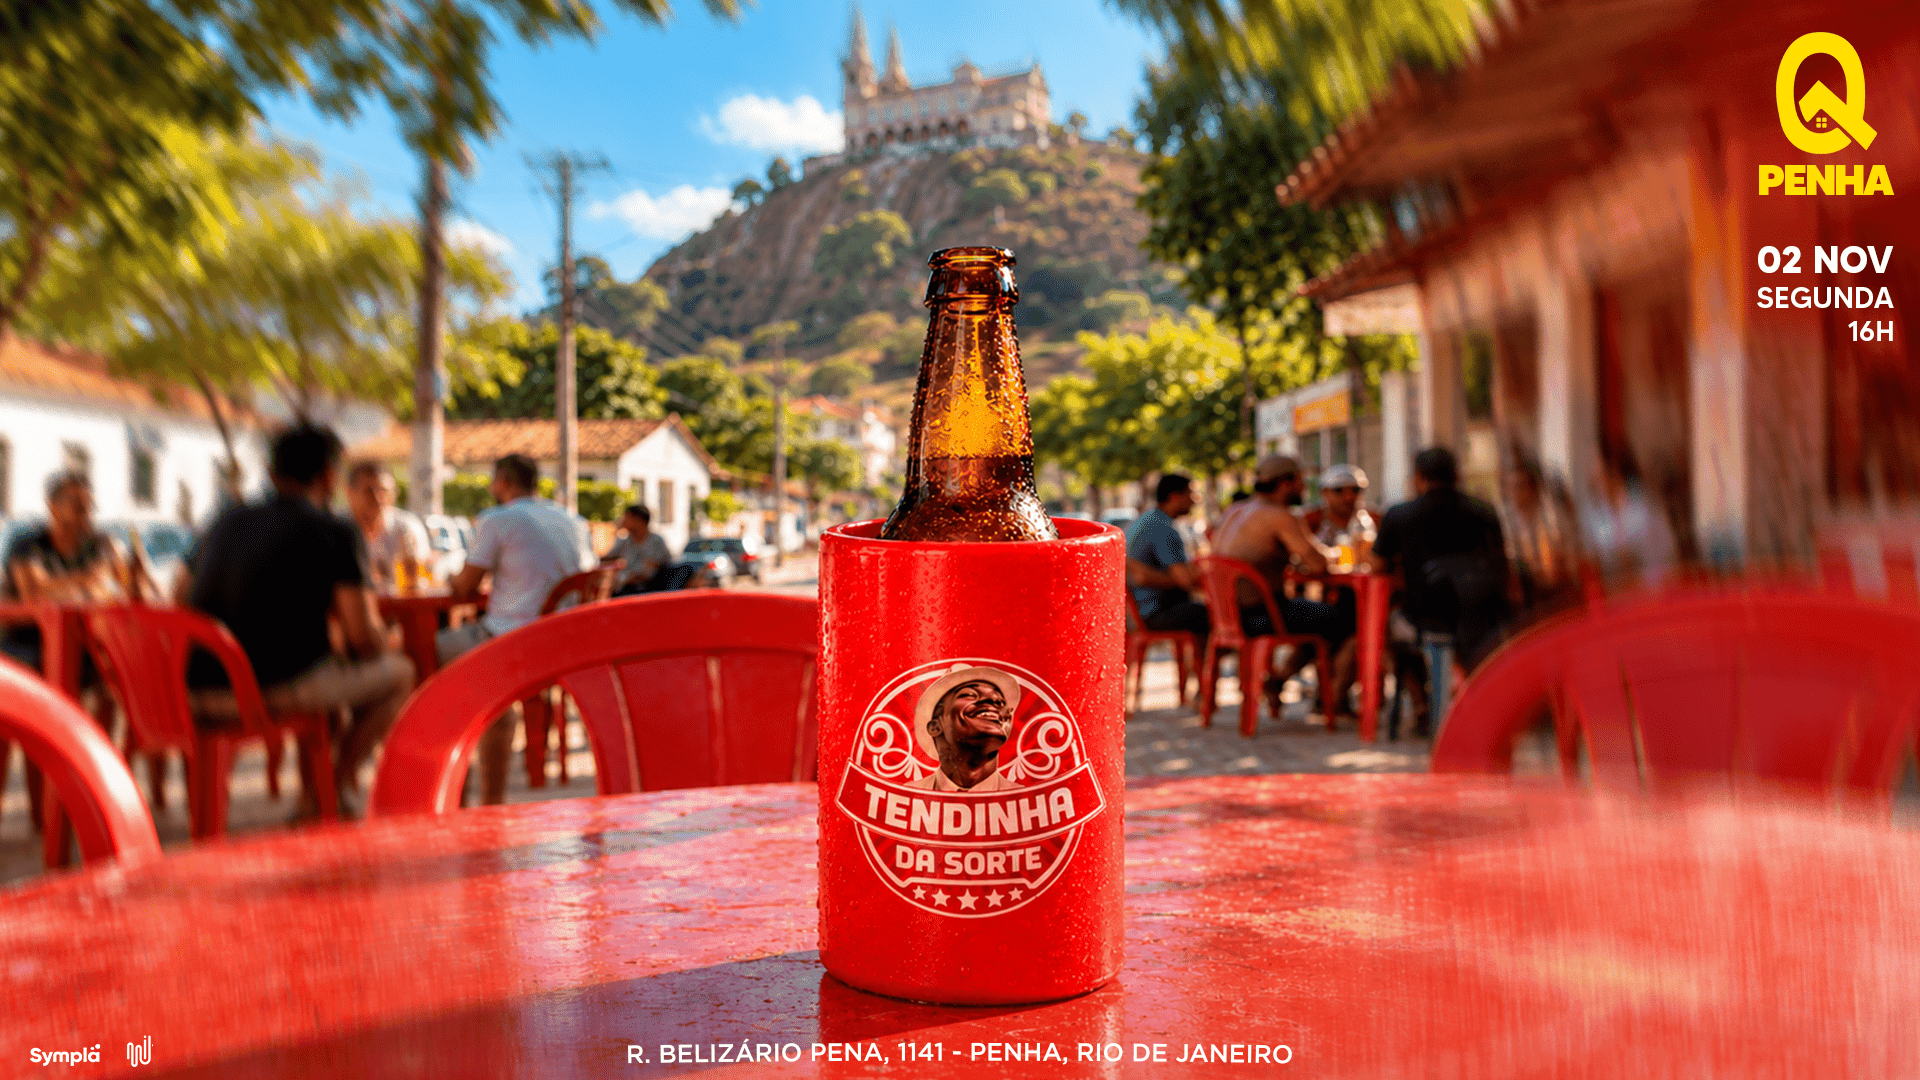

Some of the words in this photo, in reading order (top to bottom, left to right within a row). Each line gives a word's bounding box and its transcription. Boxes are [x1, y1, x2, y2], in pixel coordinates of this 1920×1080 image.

[864, 783, 1076, 836] TENDINHA
[895, 844, 935, 873] DA
[944, 845, 1042, 875] SORTE
